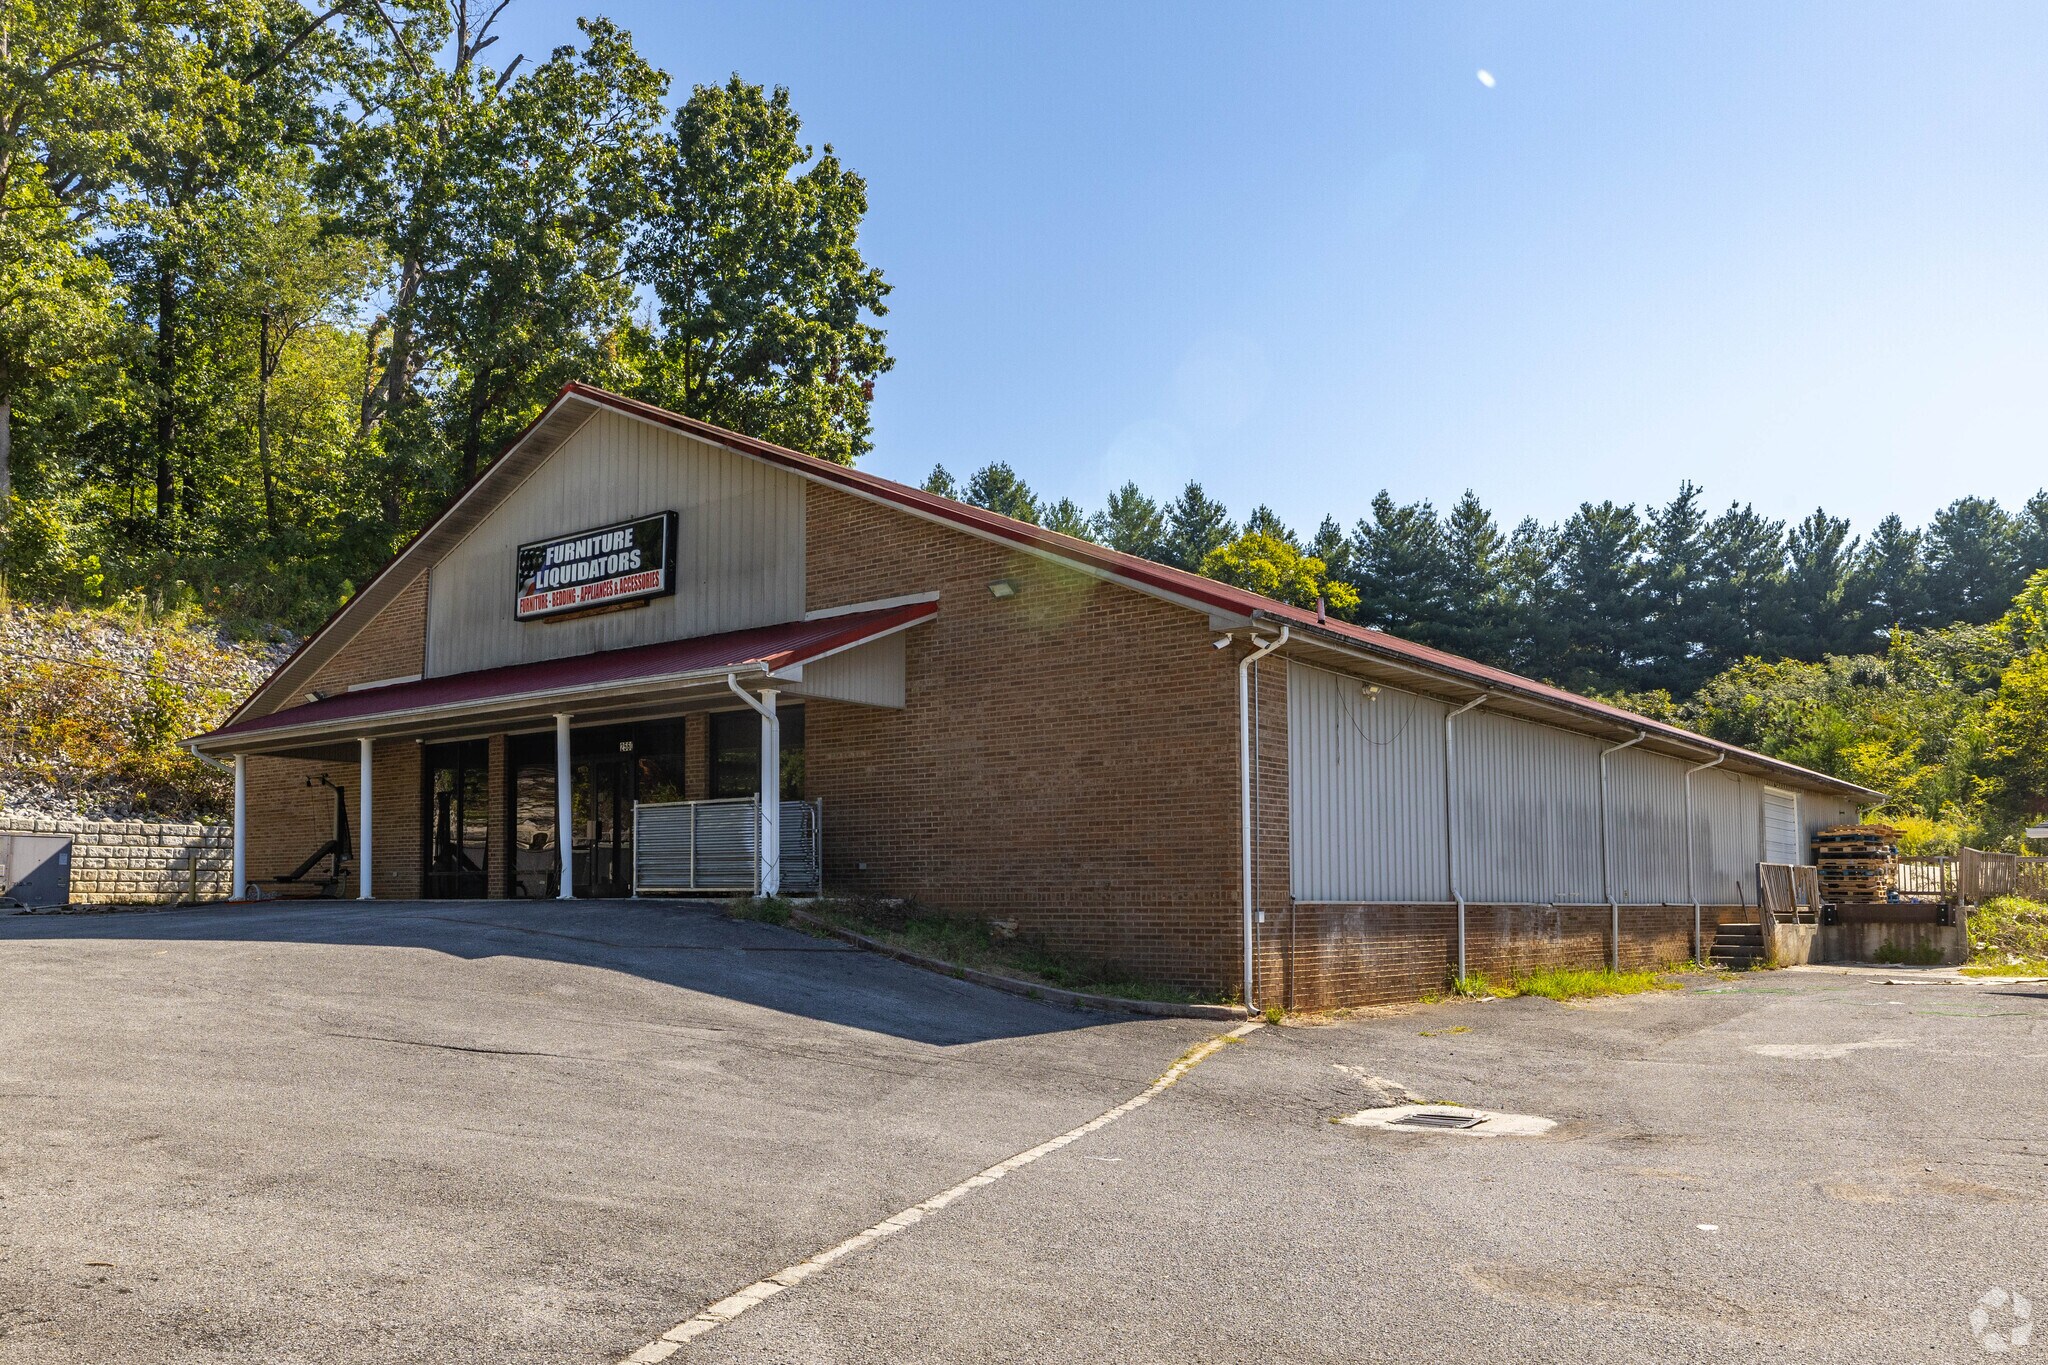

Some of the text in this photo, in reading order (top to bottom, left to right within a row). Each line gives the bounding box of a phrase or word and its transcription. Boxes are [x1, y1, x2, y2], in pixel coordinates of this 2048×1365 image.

[545, 528, 634, 566] FURNITURE
[535, 549, 641, 590] LIQUIDATORS
[519, 571, 660, 614] FURNITURE BEDDING APPLIANCES & ACCESSORIES
